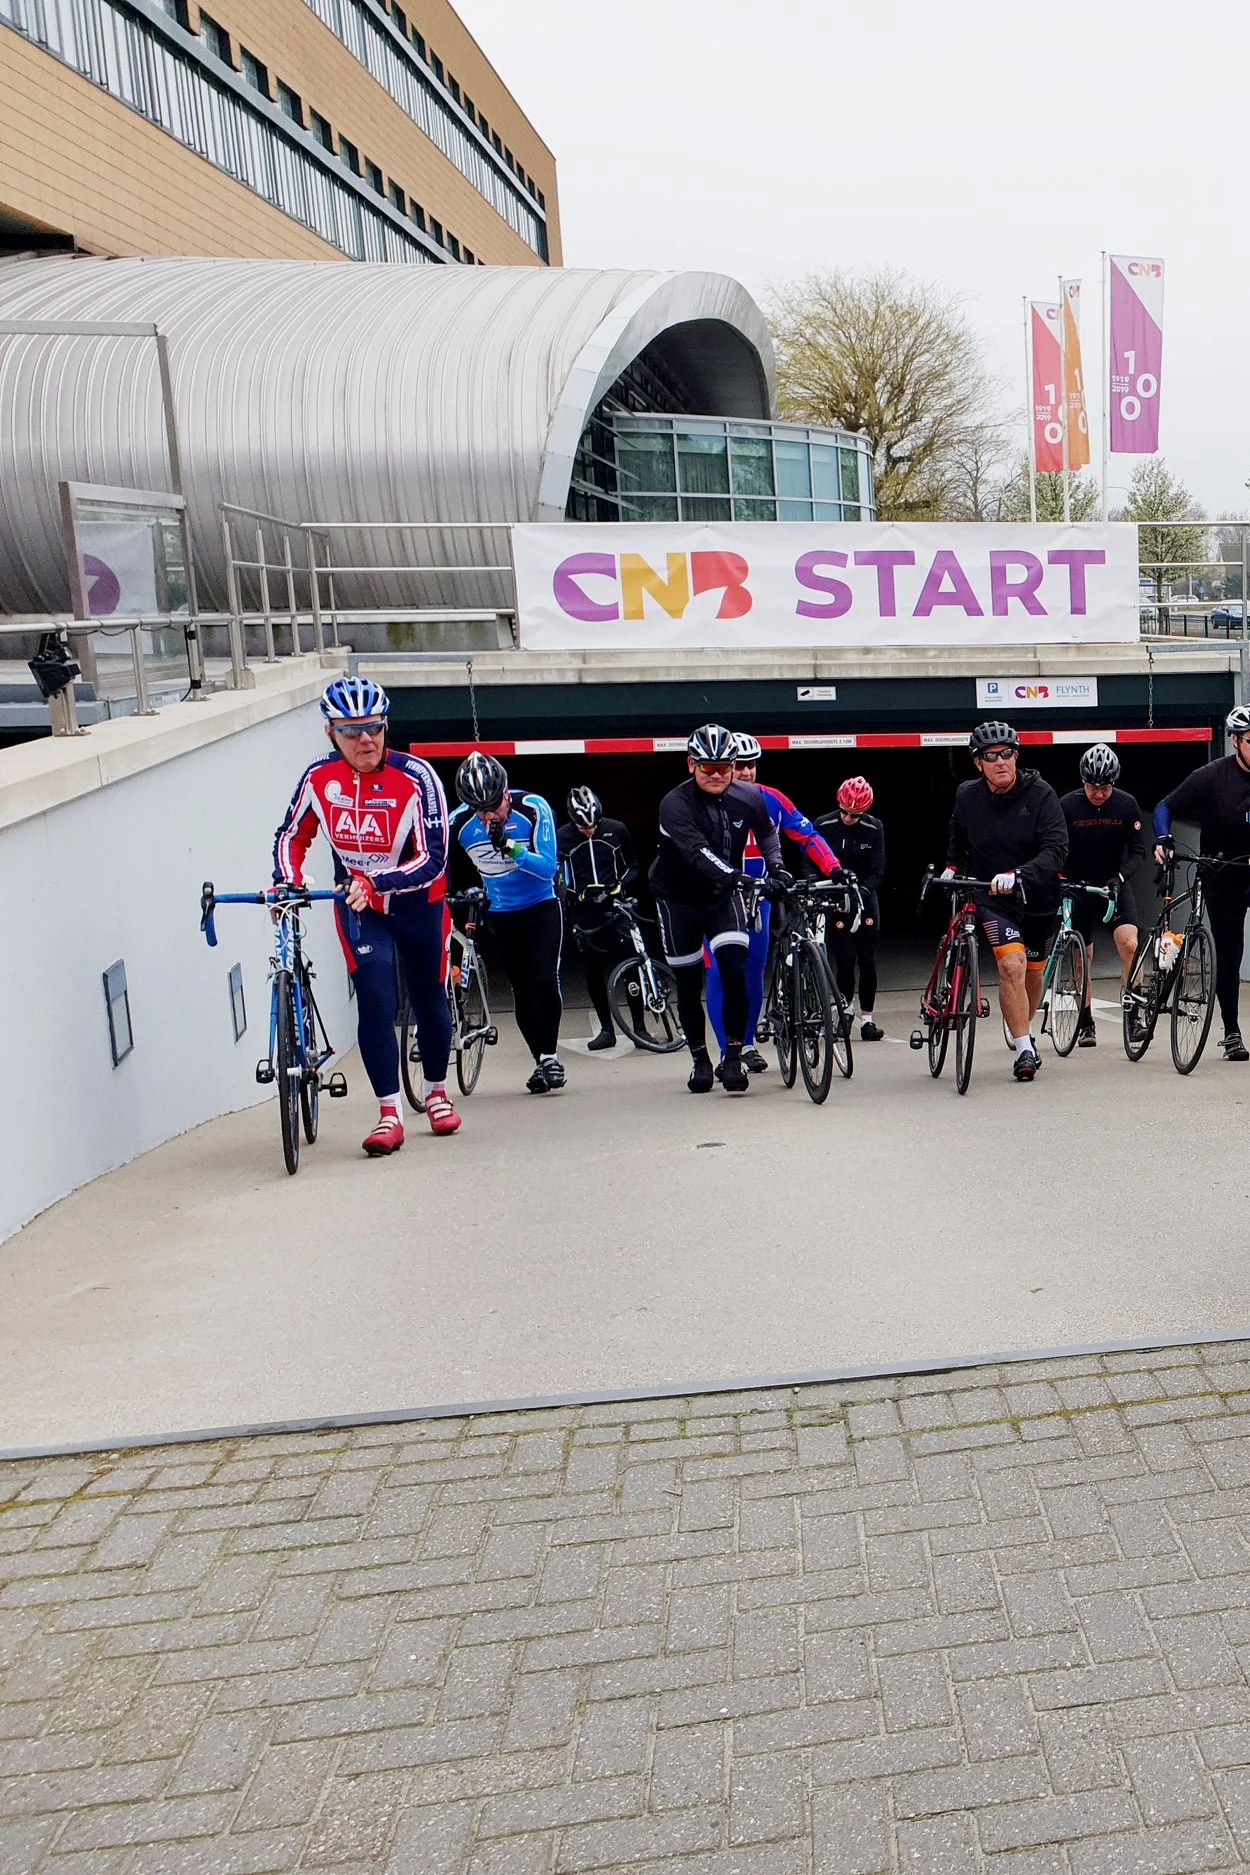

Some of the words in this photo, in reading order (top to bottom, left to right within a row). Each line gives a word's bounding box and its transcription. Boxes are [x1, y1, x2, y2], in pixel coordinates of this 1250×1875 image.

[1127, 262, 1162, 278] CNB
[1111, 386, 1130, 394] 2019
[552, 551, 754, 622] CNB
[794, 550, 1107, 619] START
[1014, 685, 1049, 699] CNB
[1056, 685, 1090, 694] FLYNTH
[334, 811, 383, 837] AA
